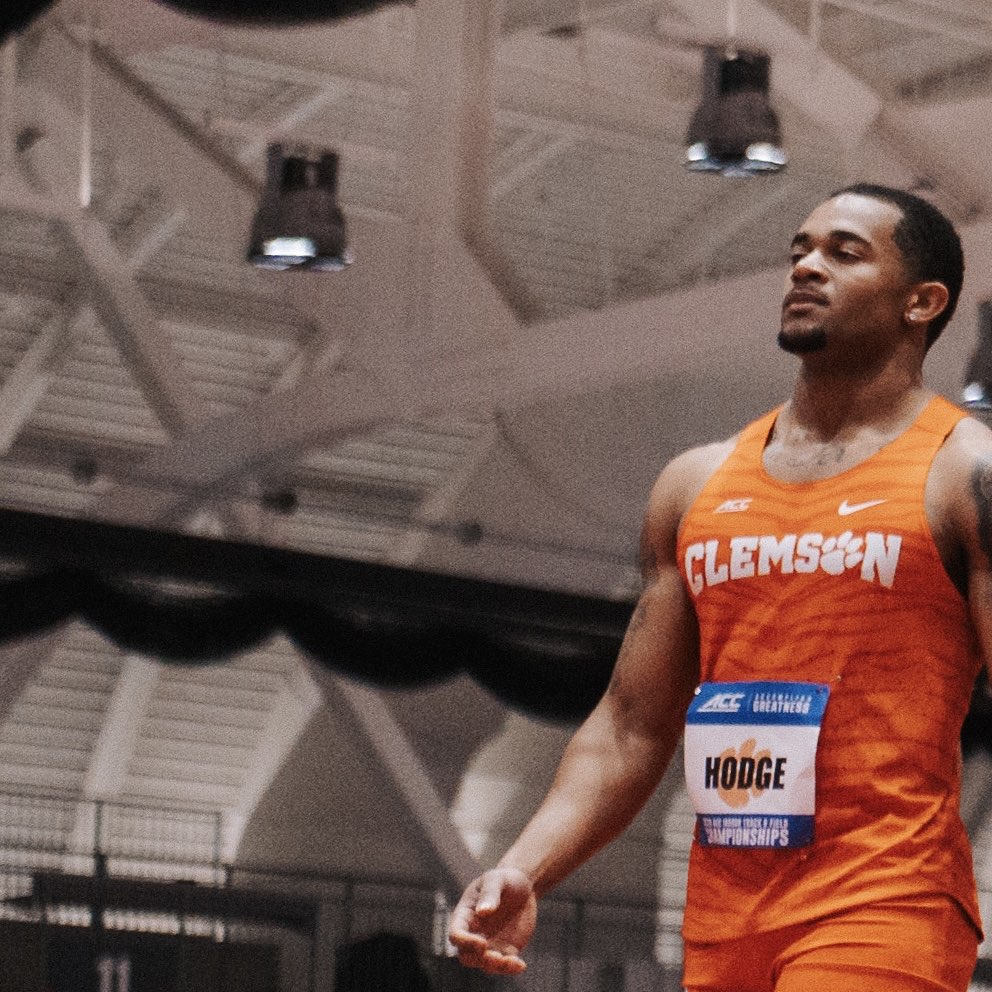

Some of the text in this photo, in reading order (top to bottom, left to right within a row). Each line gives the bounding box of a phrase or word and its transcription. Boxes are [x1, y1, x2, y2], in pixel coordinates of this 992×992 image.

[697, 693, 745, 713] ACC
[752, 700, 811, 714] GREATNESS
[705, 756, 787, 790] HODGE
